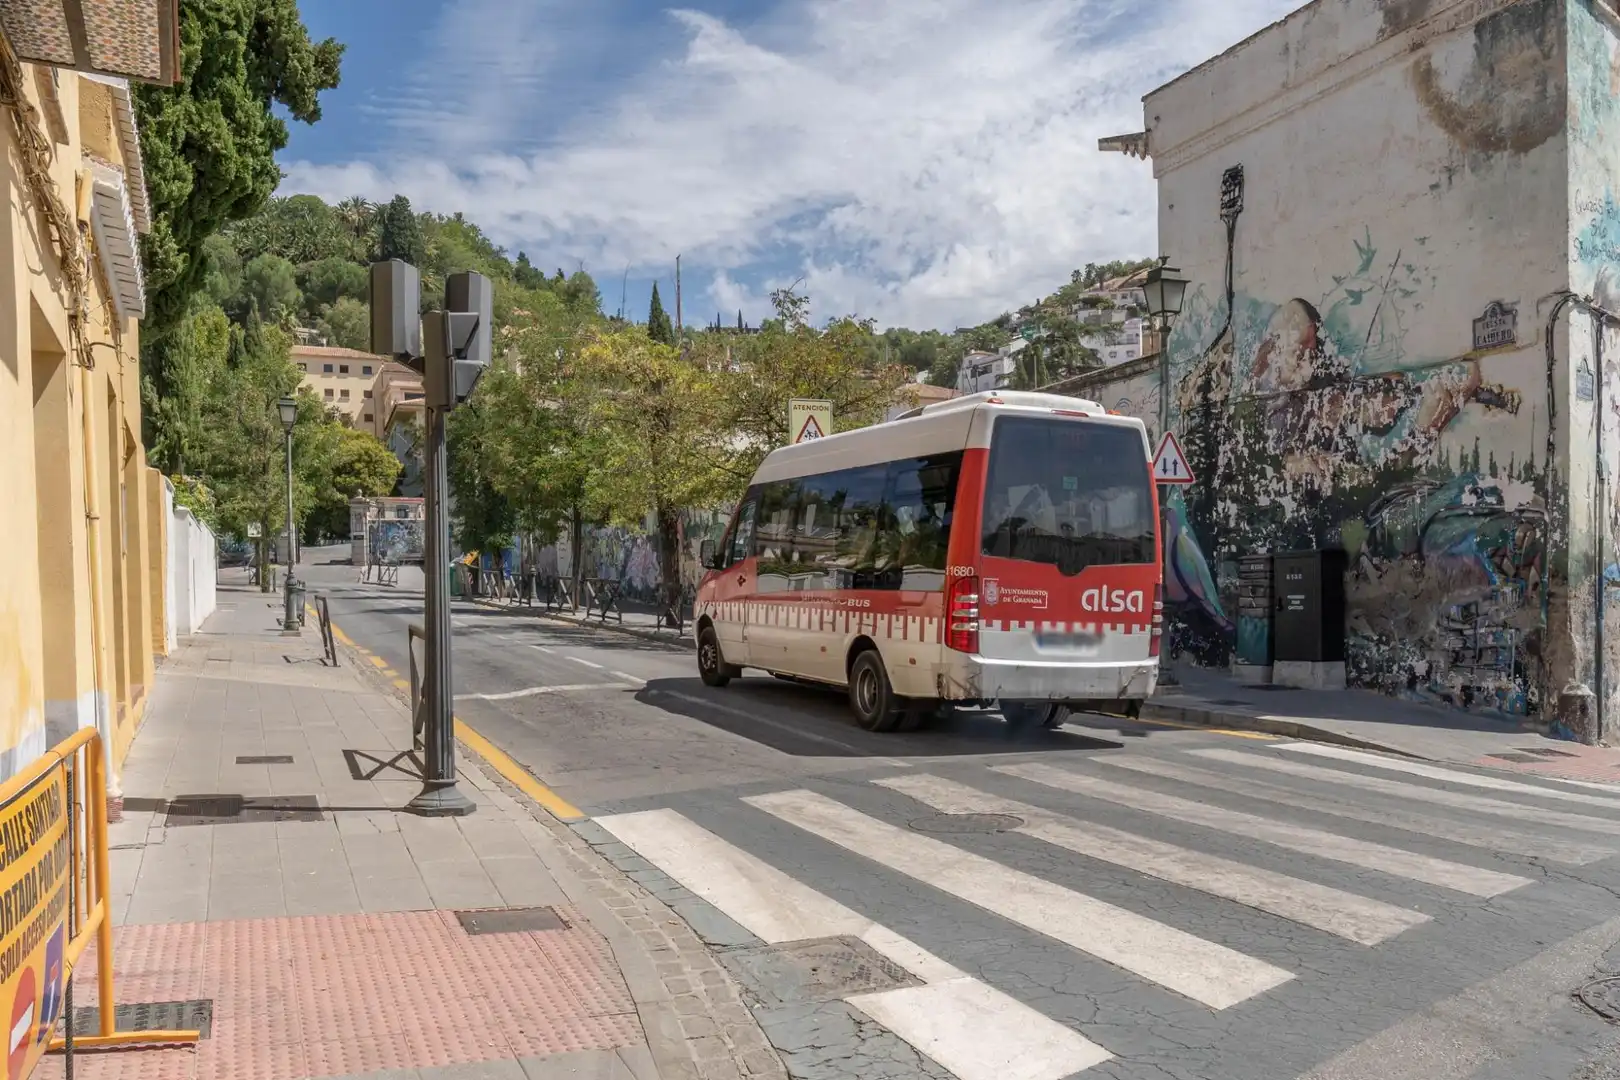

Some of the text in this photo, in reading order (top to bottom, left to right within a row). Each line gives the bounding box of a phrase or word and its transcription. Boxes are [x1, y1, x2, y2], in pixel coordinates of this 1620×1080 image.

[847, 598, 870, 607] BUS
[1081, 584, 1143, 612] alsa
[0, 937, 20, 985] SOLO
